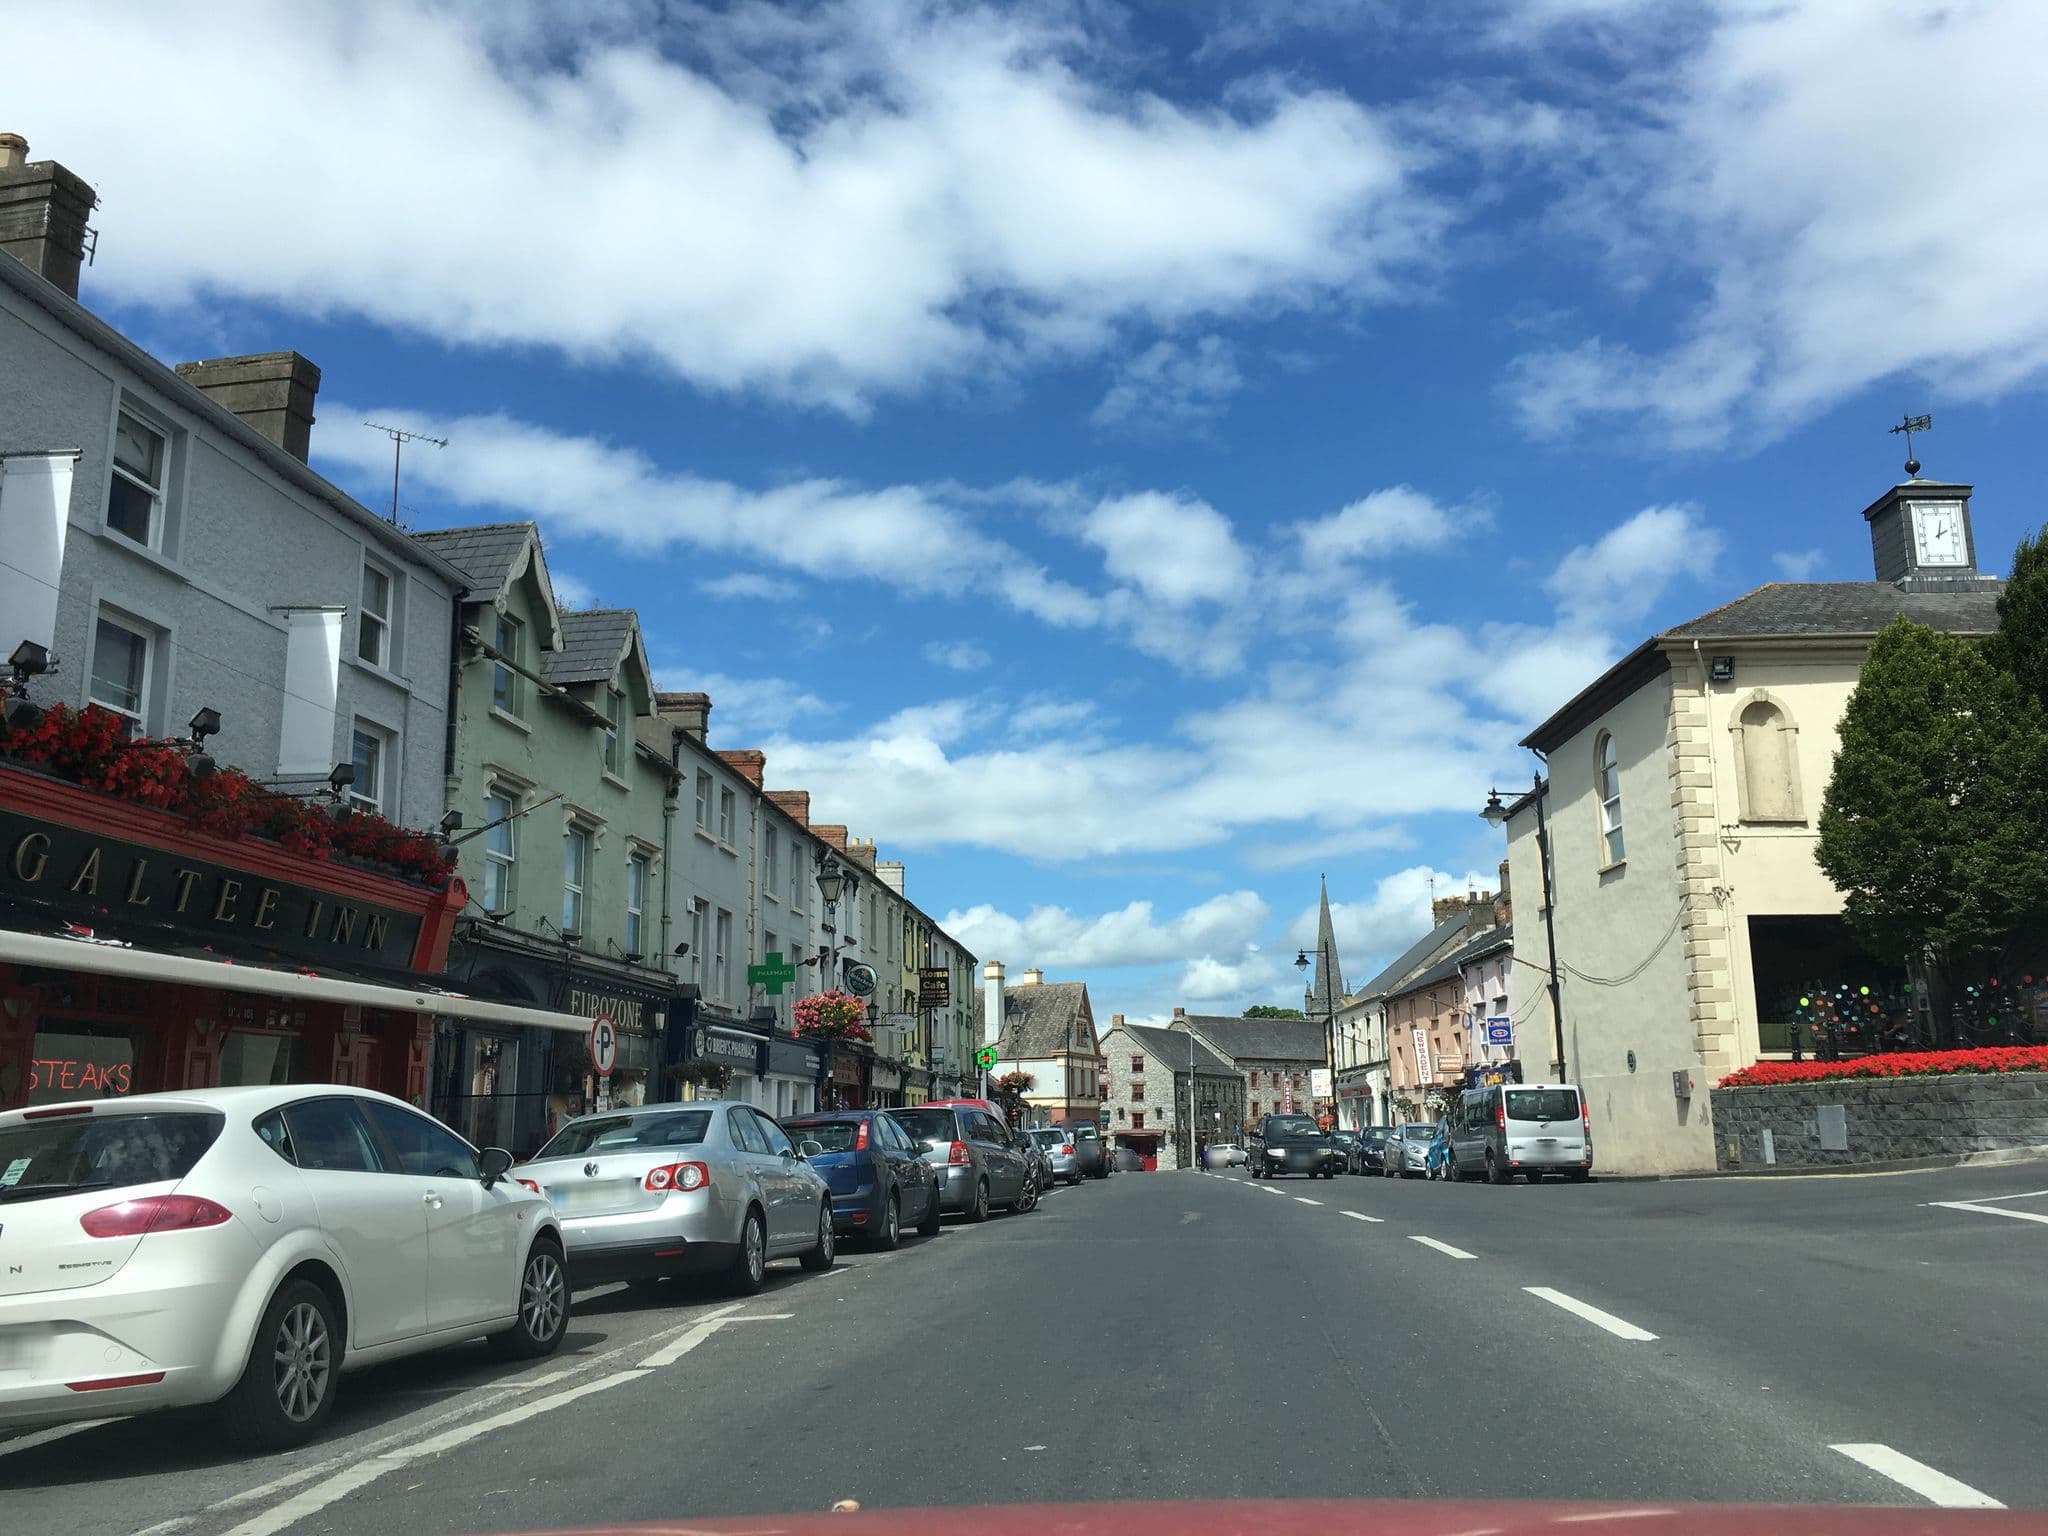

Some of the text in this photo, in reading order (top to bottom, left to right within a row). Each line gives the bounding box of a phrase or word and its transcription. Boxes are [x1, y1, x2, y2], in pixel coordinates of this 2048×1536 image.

[15, 832, 391, 951] GALTEE INN
[920, 970, 949, 978] Roma
[571, 990, 643, 1029] EUROZONE
[29, 1059, 132, 1092] STEAKS
[1416, 1031, 1430, 1082] NEWSAGENT
